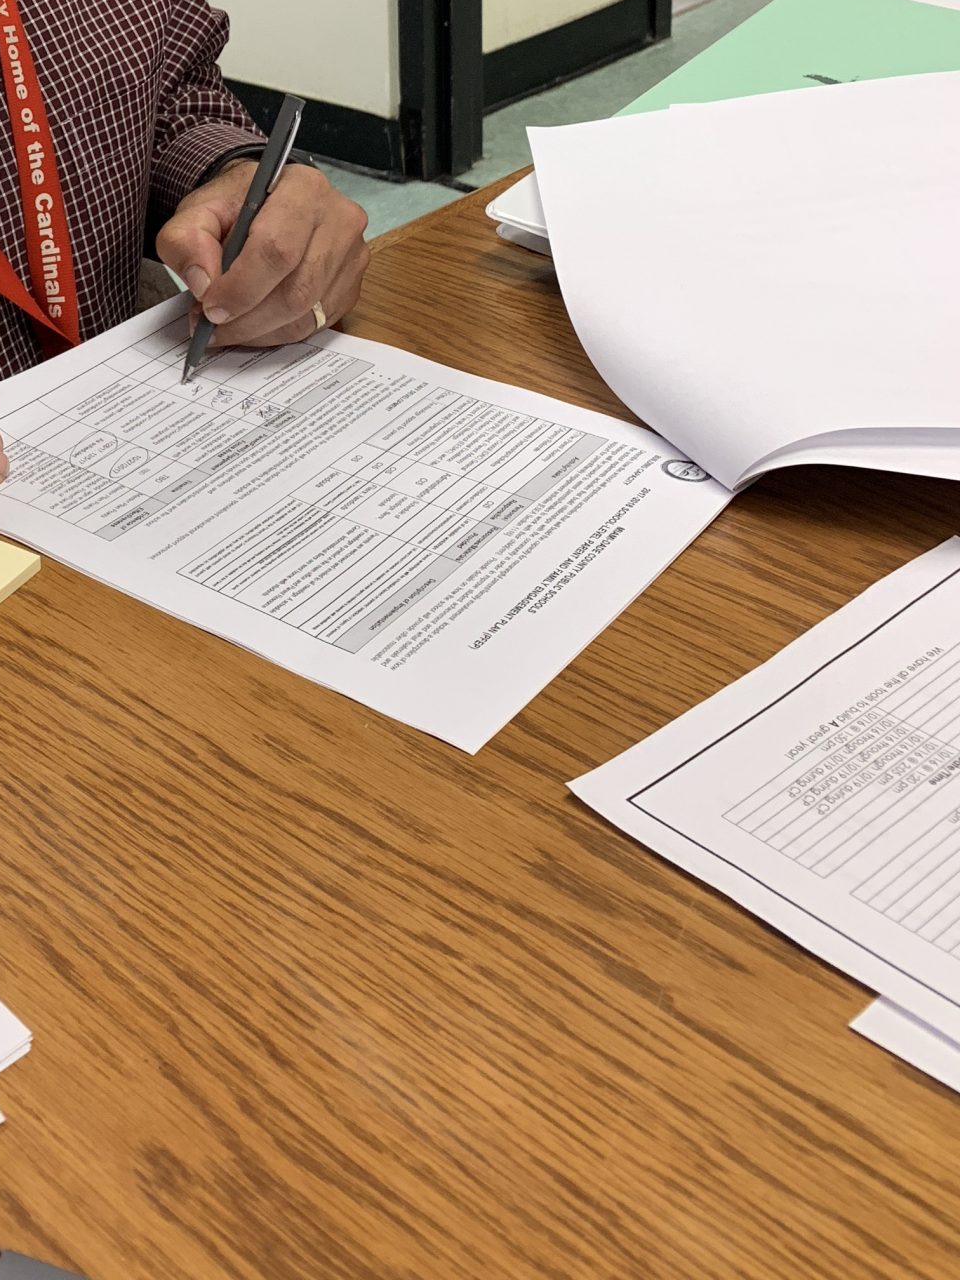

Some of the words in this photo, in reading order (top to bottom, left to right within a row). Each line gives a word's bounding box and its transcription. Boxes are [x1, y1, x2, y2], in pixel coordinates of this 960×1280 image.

[2, 25, 29, 100] Home
[20, 107, 38, 134] of
[26, 142, 46, 186] the
[34, 193, 65, 319] Cardinals
[589, 506, 629, 539] SCHOOL-LEVEL
[570, 539, 594, 559] PARENT
[591, 526, 625, 554] MIAMI-DADE
[558, 557, 574, 569] AND
[572, 552, 596, 573] COUNTY
[541, 568, 563, 587] FAMILY
[552, 571, 576, 590] PUBLIC
[408, 578, 436, 599] Description
[504, 585, 544, 620] ENGAGEMENT
[527, 589, 557, 613] SCHOOLS
[487, 618, 508, 633] PLAN
[468, 631, 492, 649] (PFEP)
[928, 646, 944, 658] We
[909, 658, 929, 673] have
[884, 677, 901, 688] the
[865, 687, 888, 702] tools
[837, 706, 861, 722] build
[856, 710, 881, 727] 10/16
[829, 720, 840, 728] A
[870, 718, 895, 735] 10/16
[808, 725, 831, 744] great
[838, 730, 875, 754] through
[884, 726, 909, 742] 10/16
[899, 734, 924, 750] 10/16
[816, 738, 836, 751] pm
[853, 738, 889, 762] through
[913, 742, 938, 758] 10/16
[823, 753, 847, 770] 10/19
[867, 746, 904, 771] through
[928, 750, 954, 766] 10/16
[793, 765, 824, 787] during
[837, 761, 861, 779] 10/19
[852, 770, 876, 787] 10/19
[873, 771, 894, 785] pm
[807, 773, 838, 796] during
[822, 782, 853, 804] during
[888, 779, 909, 793] pm
